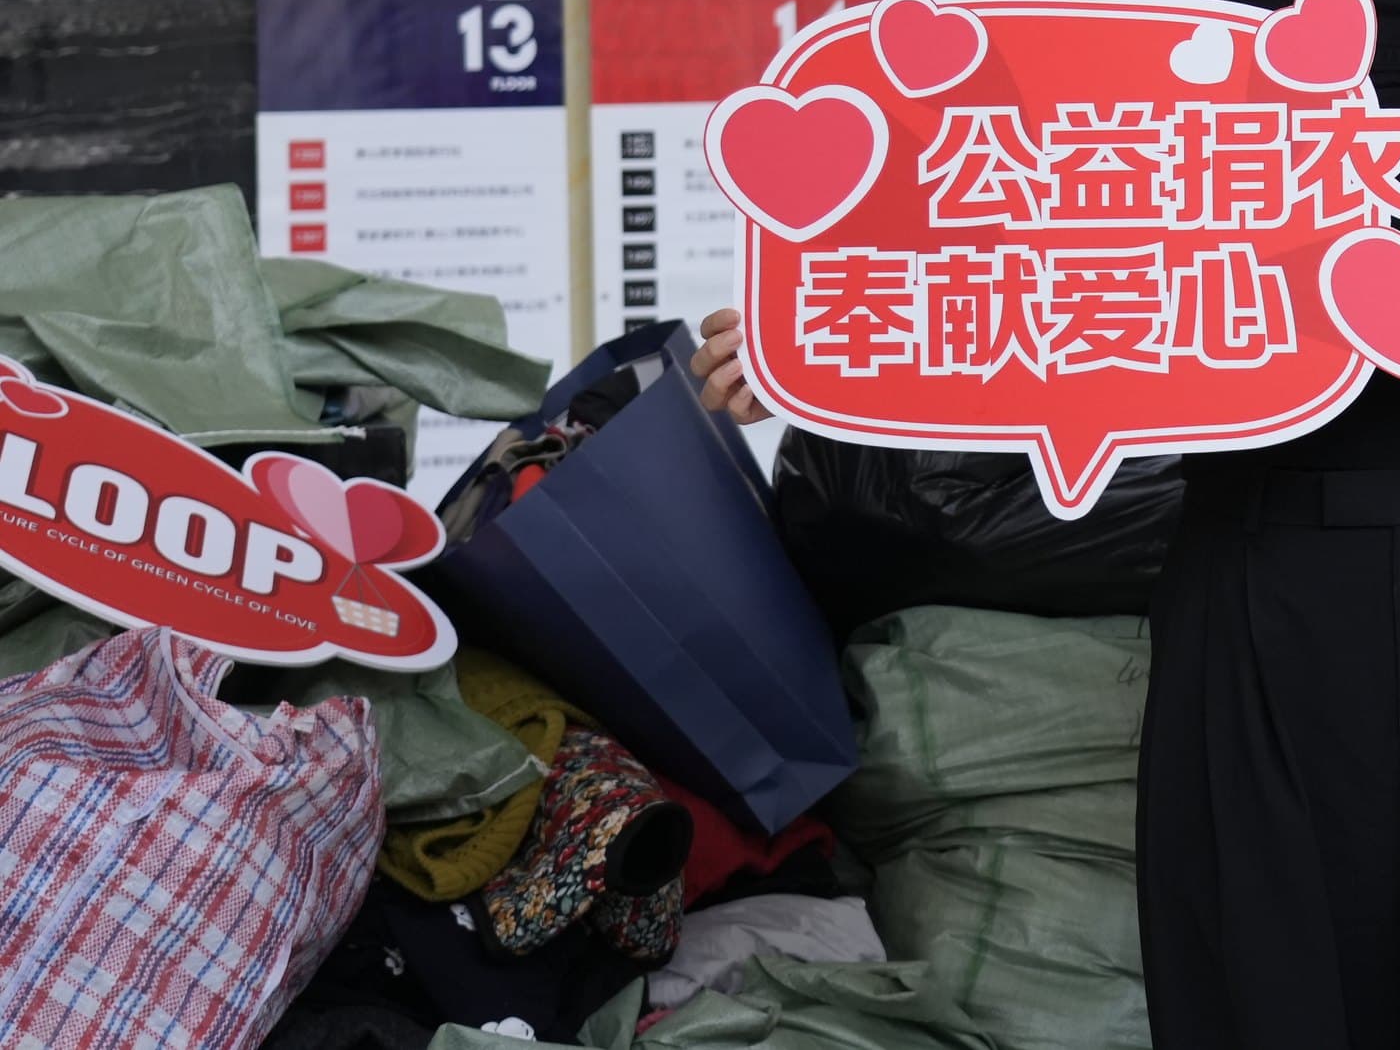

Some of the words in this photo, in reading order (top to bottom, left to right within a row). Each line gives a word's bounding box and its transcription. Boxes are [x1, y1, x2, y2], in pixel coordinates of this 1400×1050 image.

[457, 3, 538, 72] 13
[797, 243, 1297, 382] 奉献爱心
[0, 432, 323, 595] LOOP
[0, 510, 39, 532] URE
[46, 528, 100, 554] CYCLE
[103, 549, 128, 564] OF
[131, 558, 188, 585] GREEN
[193, 580, 244, 606] CYCLE
[248, 601, 272, 614] OF
[275, 609, 318, 631] LOVE
